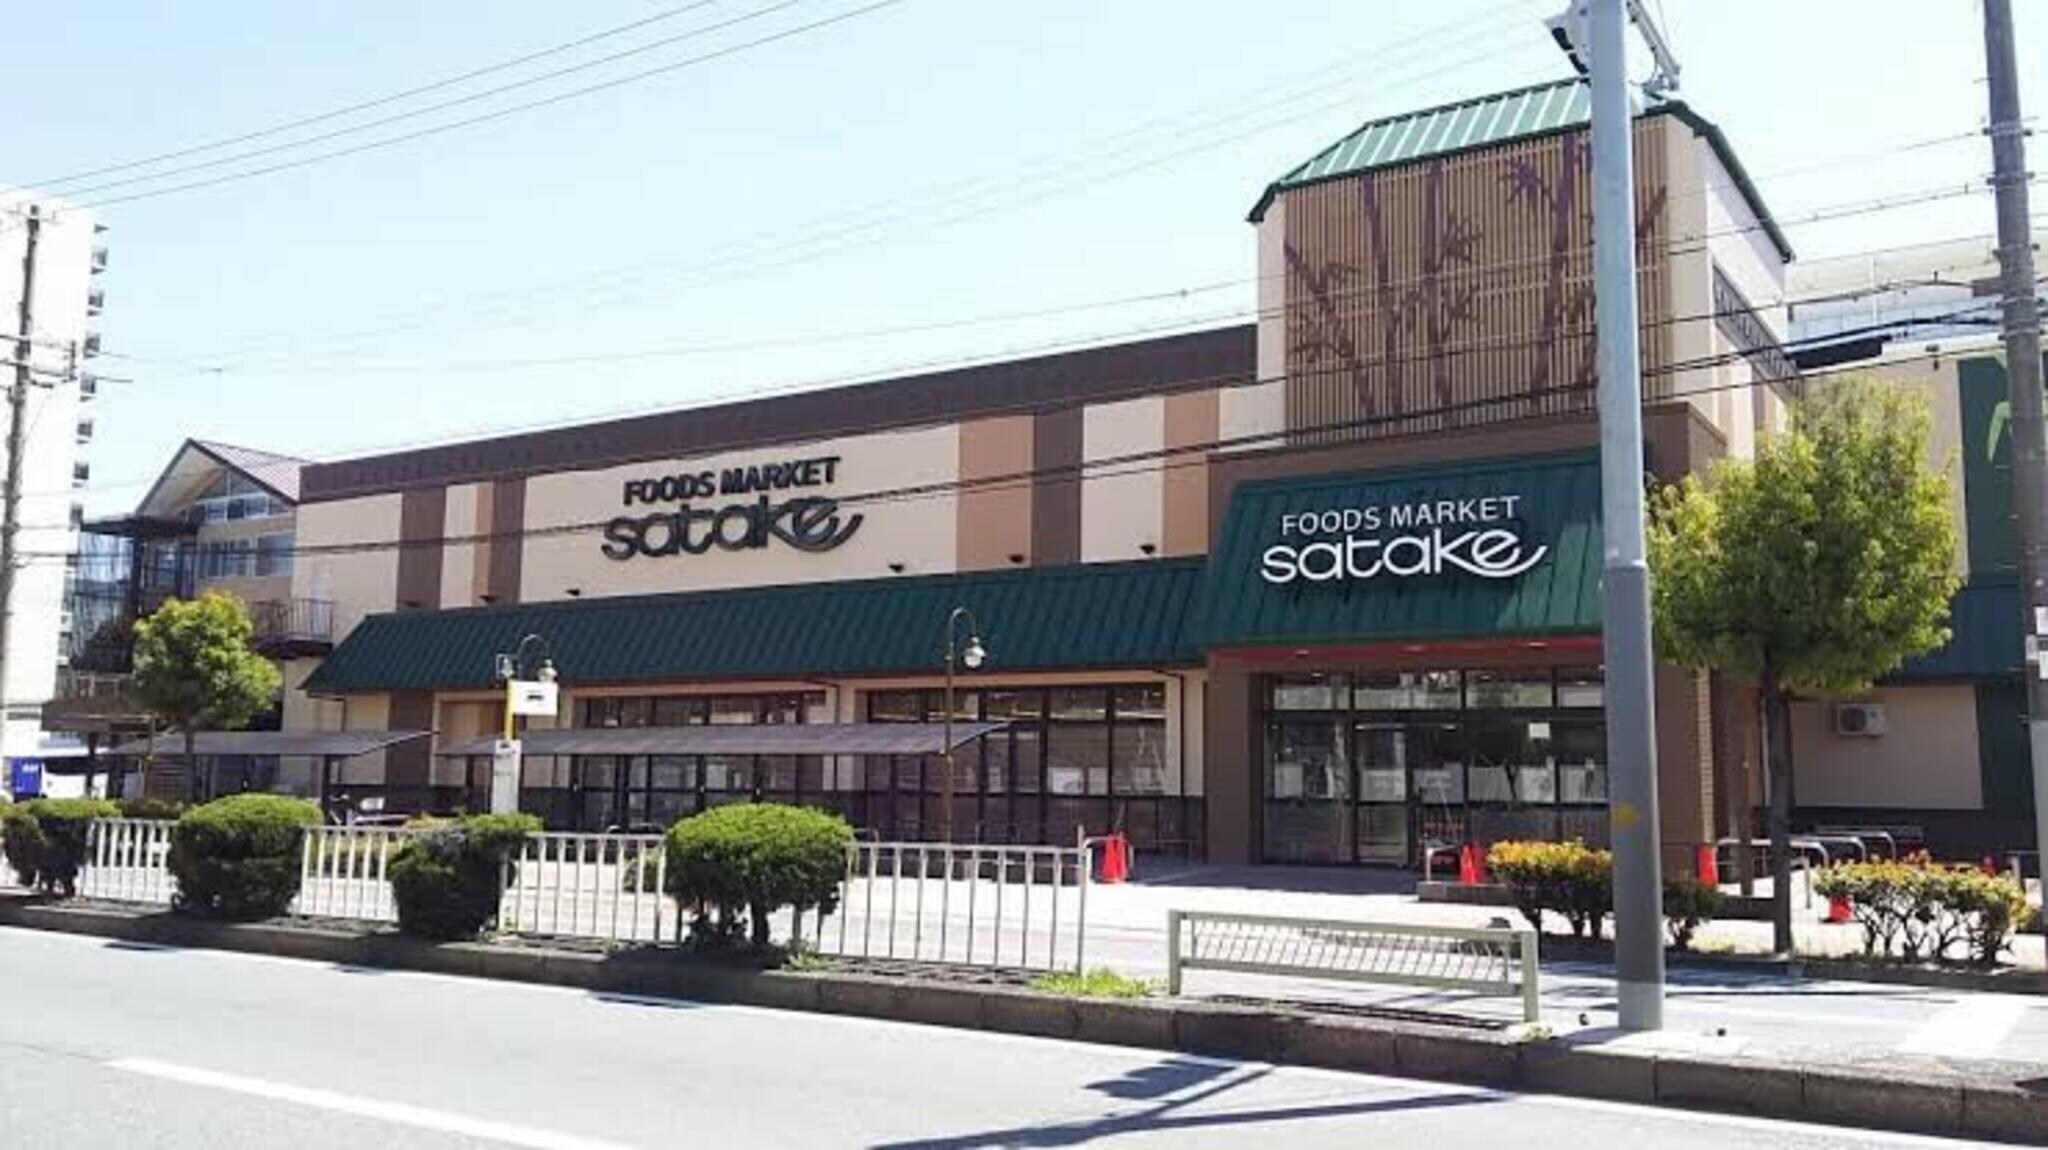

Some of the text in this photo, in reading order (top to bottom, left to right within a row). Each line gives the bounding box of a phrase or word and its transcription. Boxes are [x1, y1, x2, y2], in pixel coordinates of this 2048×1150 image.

[623, 456, 841, 506] FOODS MARKET
[601, 495, 864, 561] satake
[1281, 495, 1521, 535] FOODS MARKET
[1260, 528, 1548, 583] satake
